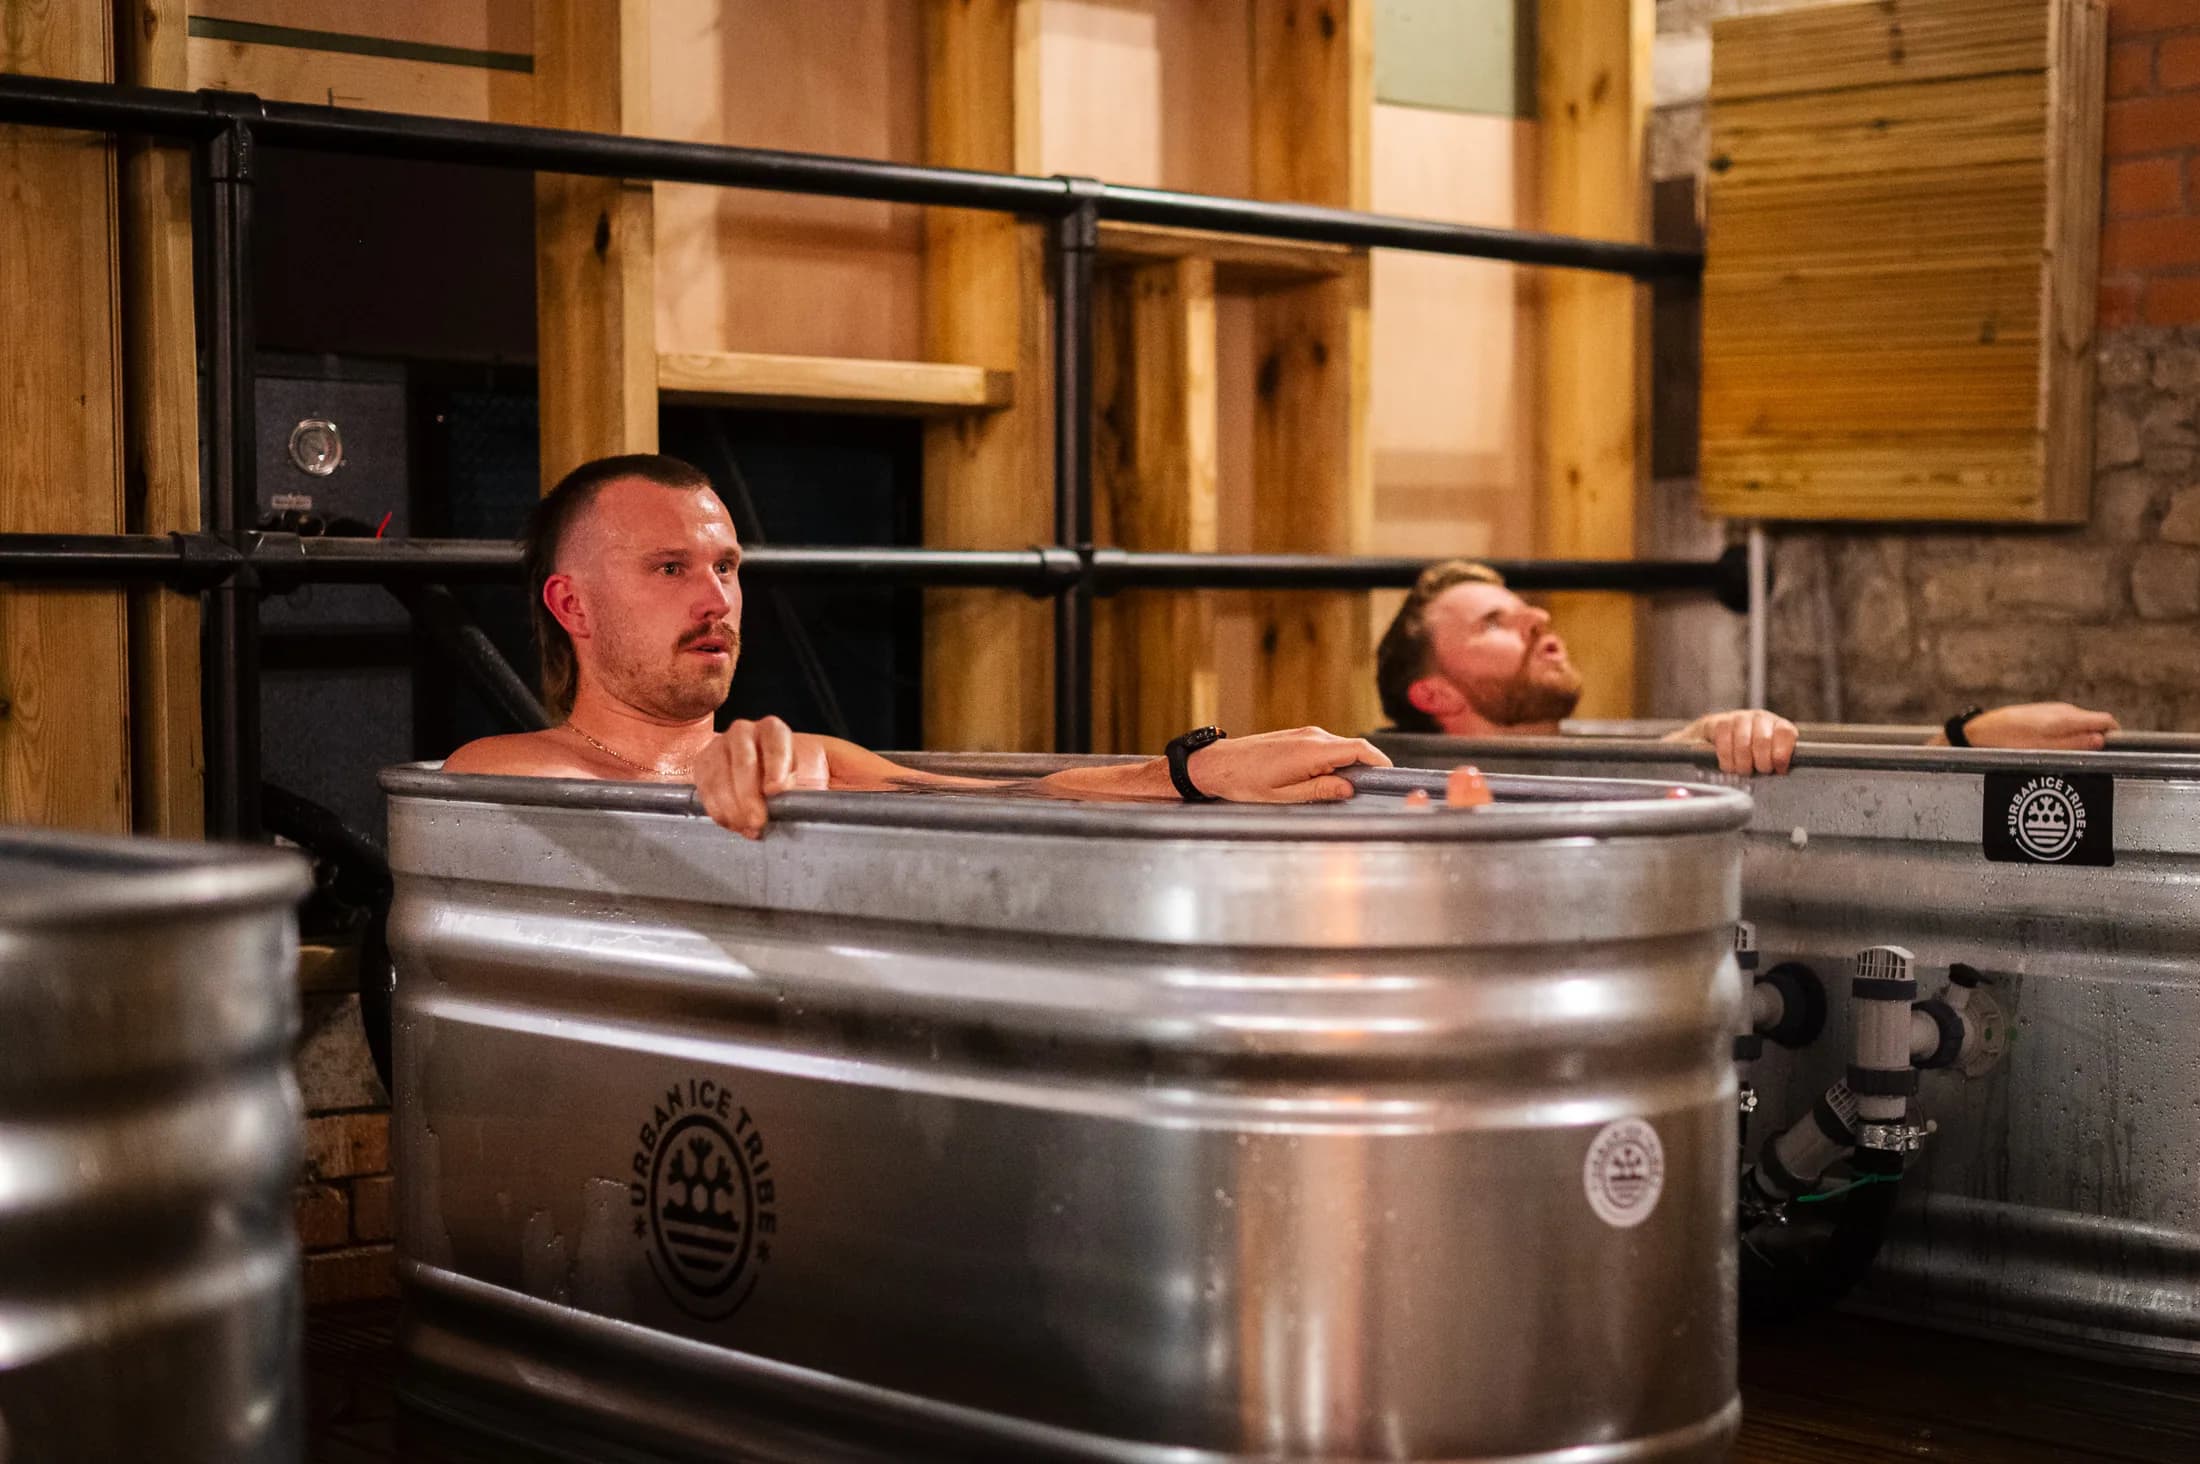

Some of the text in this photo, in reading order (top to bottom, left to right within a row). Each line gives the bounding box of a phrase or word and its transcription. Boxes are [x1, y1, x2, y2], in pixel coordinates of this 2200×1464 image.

[2008, 777, 2087, 828] URBAN ICE TRIBE
[631, 1079, 777, 1233] URBAN ICE TRIBE
